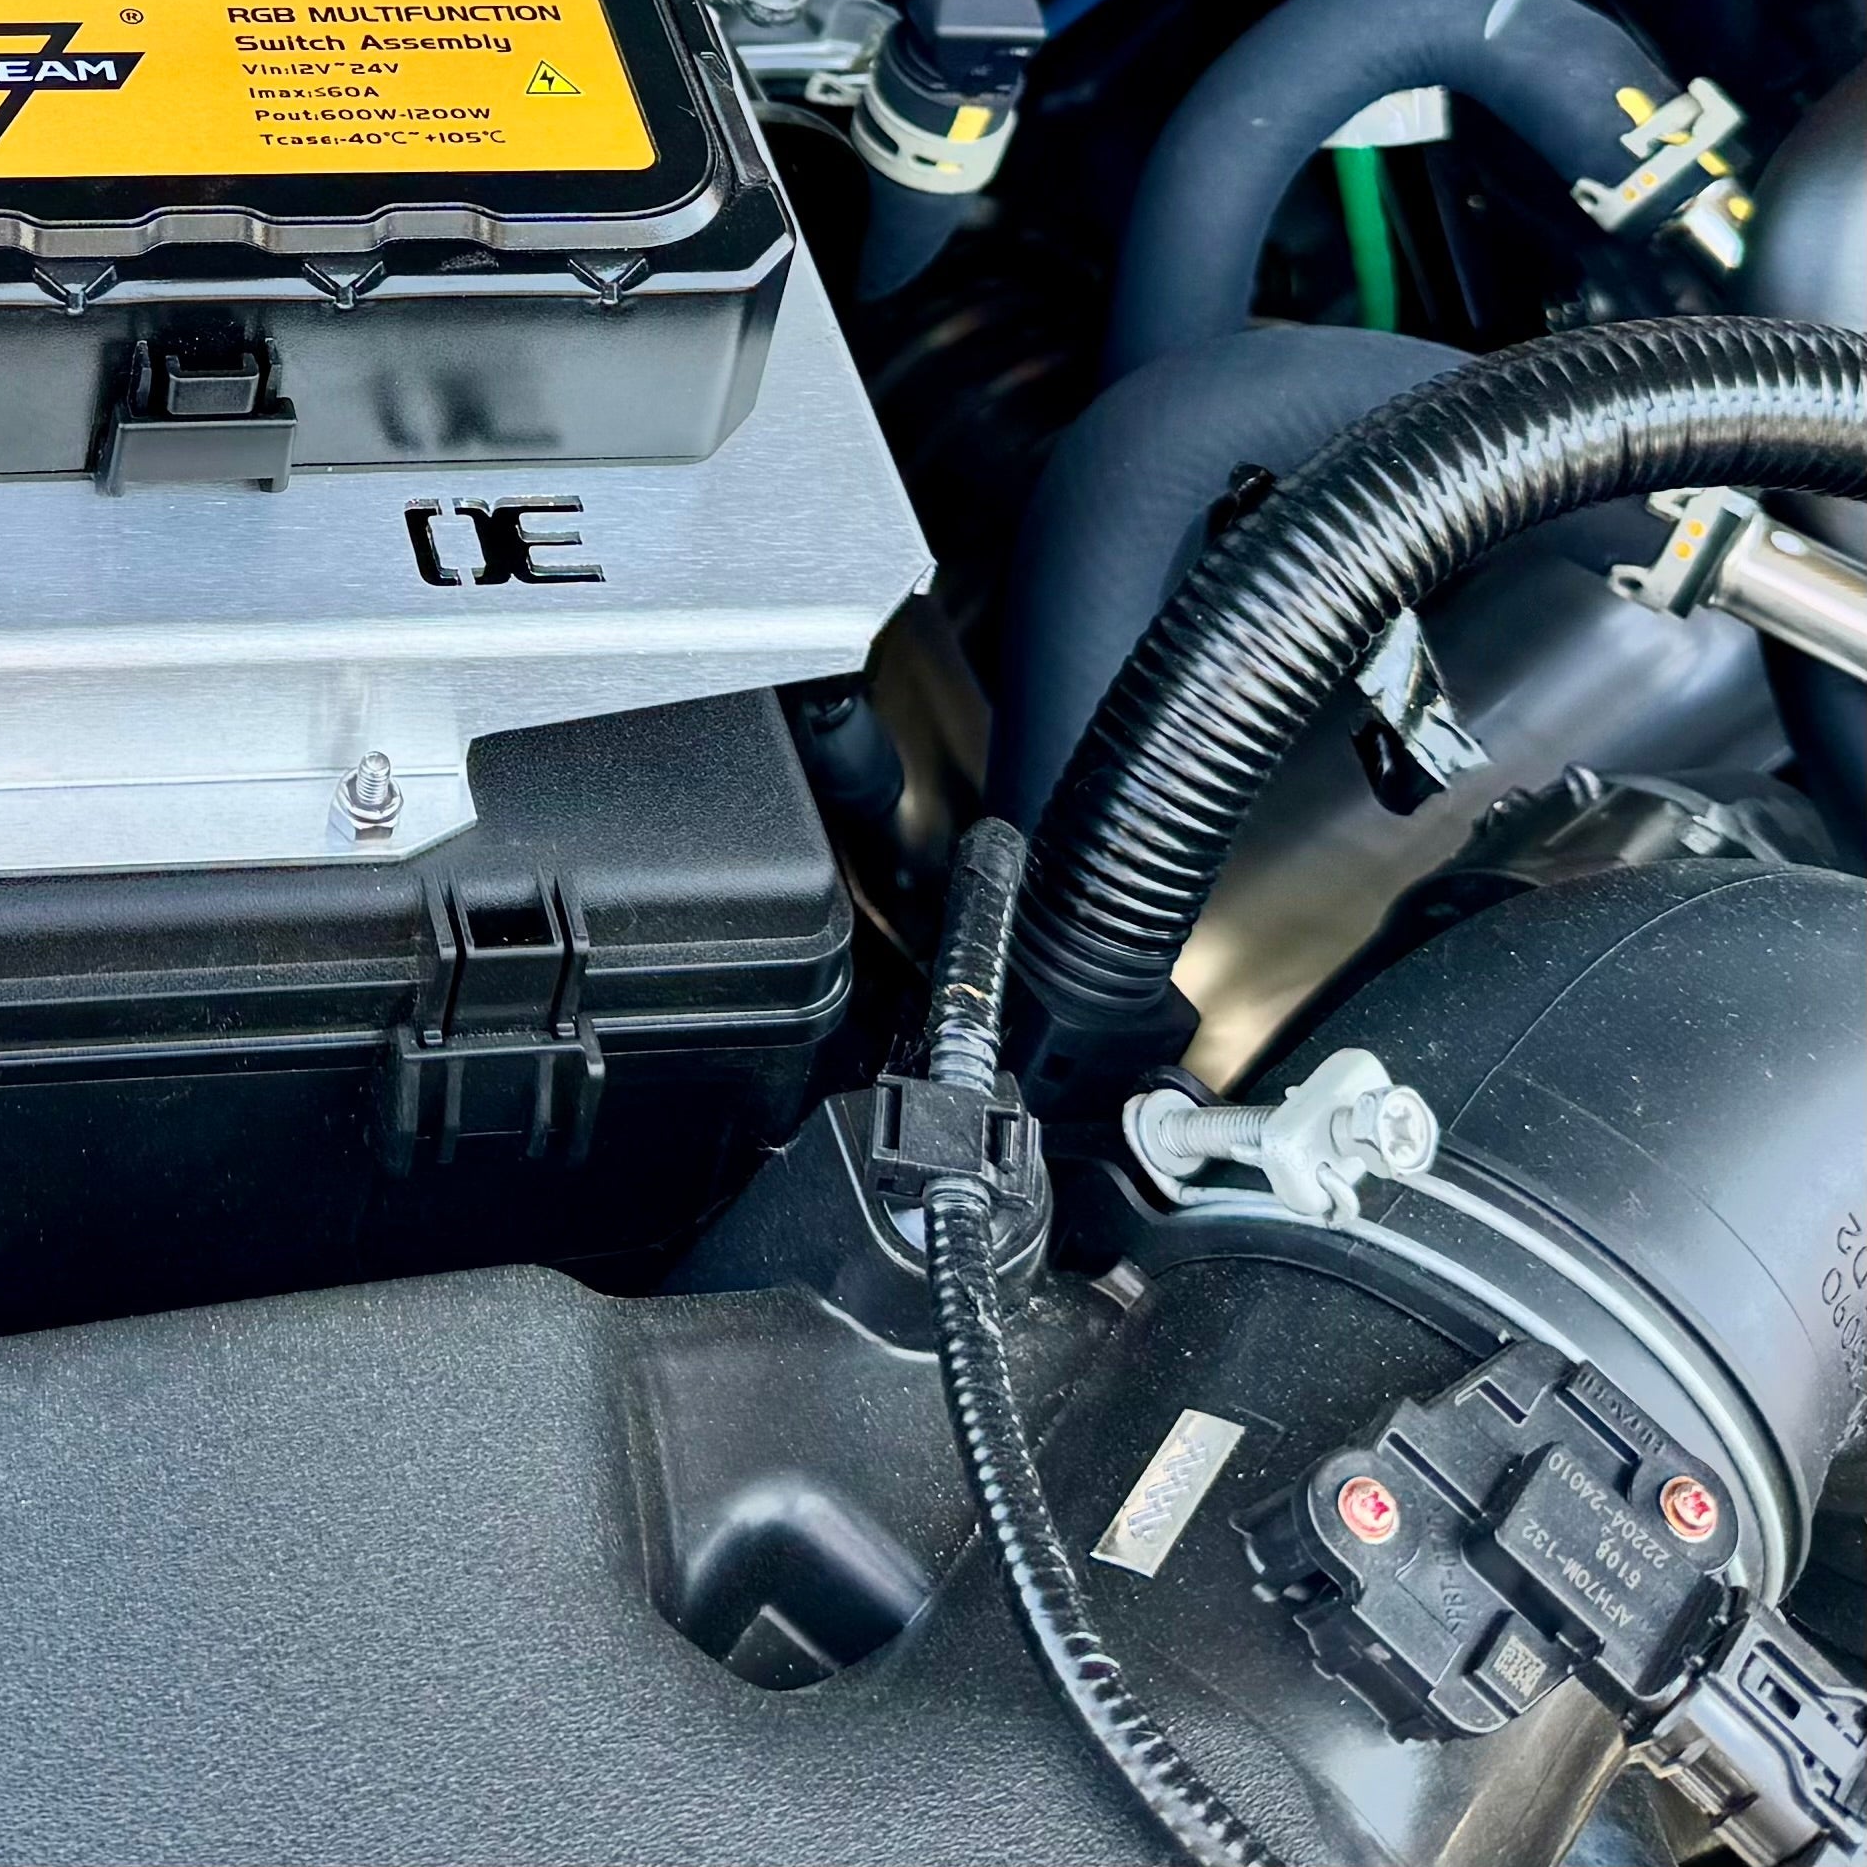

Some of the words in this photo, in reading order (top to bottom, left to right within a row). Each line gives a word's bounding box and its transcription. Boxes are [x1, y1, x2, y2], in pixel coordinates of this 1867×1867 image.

[227, 7, 296, 23] RGB
[308, 5, 562, 23] MULTIFUNCTION
[235, 35, 346, 51] Switch
[361, 33, 512, 53] Assembly
[255, 107, 490, 122] Pout:600W-1200W
[1546, 1449, 1670, 1570] 22204-24010
[1519, 1516, 1637, 1628] AFH70M-132
